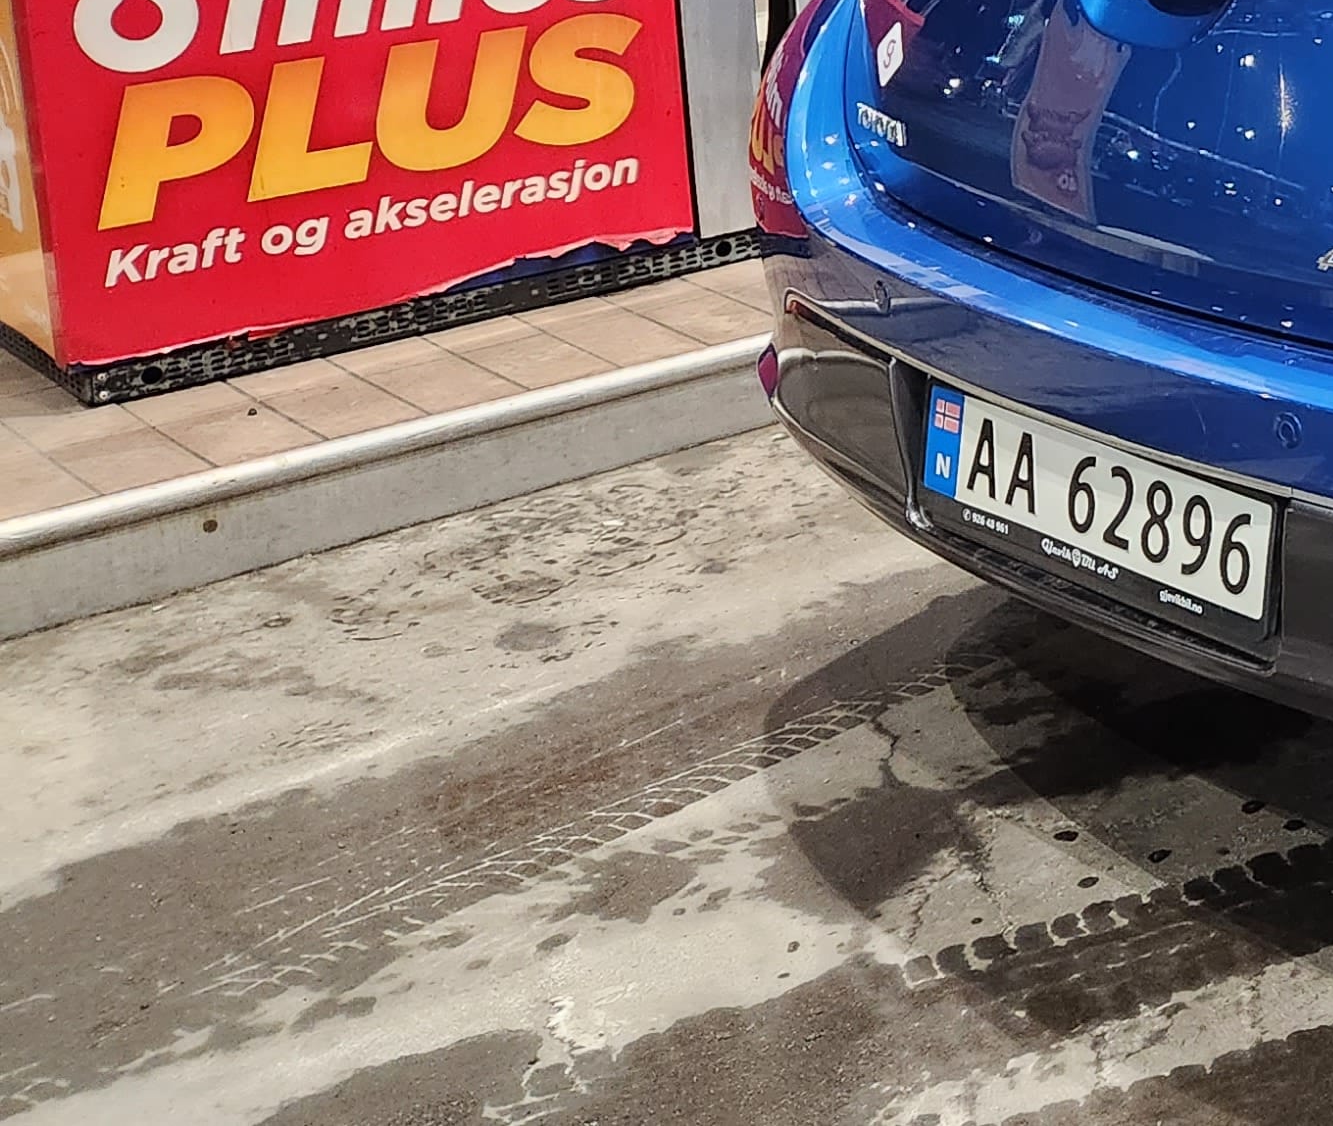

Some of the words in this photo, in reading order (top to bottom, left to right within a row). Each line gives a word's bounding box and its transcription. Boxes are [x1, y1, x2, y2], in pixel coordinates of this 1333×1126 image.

[97, 12, 643, 232] PLUS
[104, 226, 248, 289] Kraft
[261, 214, 329, 263] og
[344, 156, 641, 243] akselerasjon
[935, 454, 951, 479] N
[966, 417, 1037, 515] AA
[1067, 455, 1252, 595] 62896
